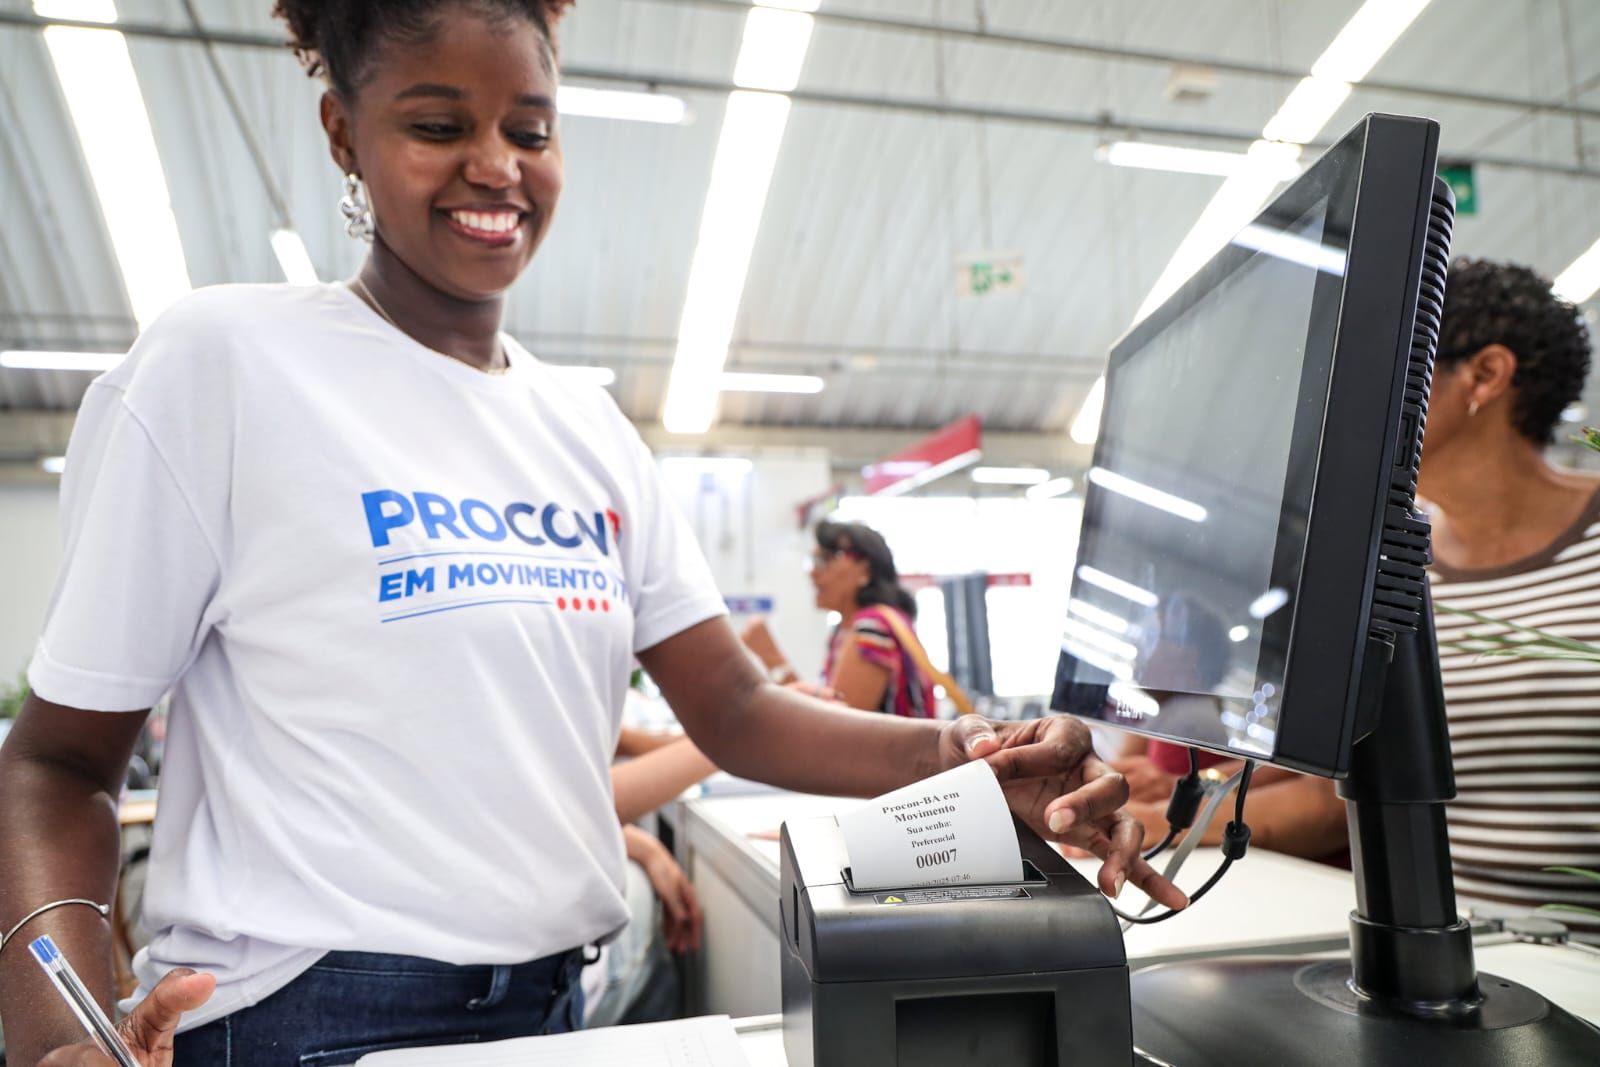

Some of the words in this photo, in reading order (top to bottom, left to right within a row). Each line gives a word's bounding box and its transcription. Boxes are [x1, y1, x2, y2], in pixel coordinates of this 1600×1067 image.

[378, 567, 435, 602] EM
[448, 563, 607, 591] MOVIMENTO
[882, 795, 941, 814] Procon-BA
[943, 791, 960, 800] em
[894, 804, 956, 823] Movimento
[906, 826, 924, 835] Sua
[911, 832, 956, 848] Preferencial
[916, 848, 957, 869] 00007
